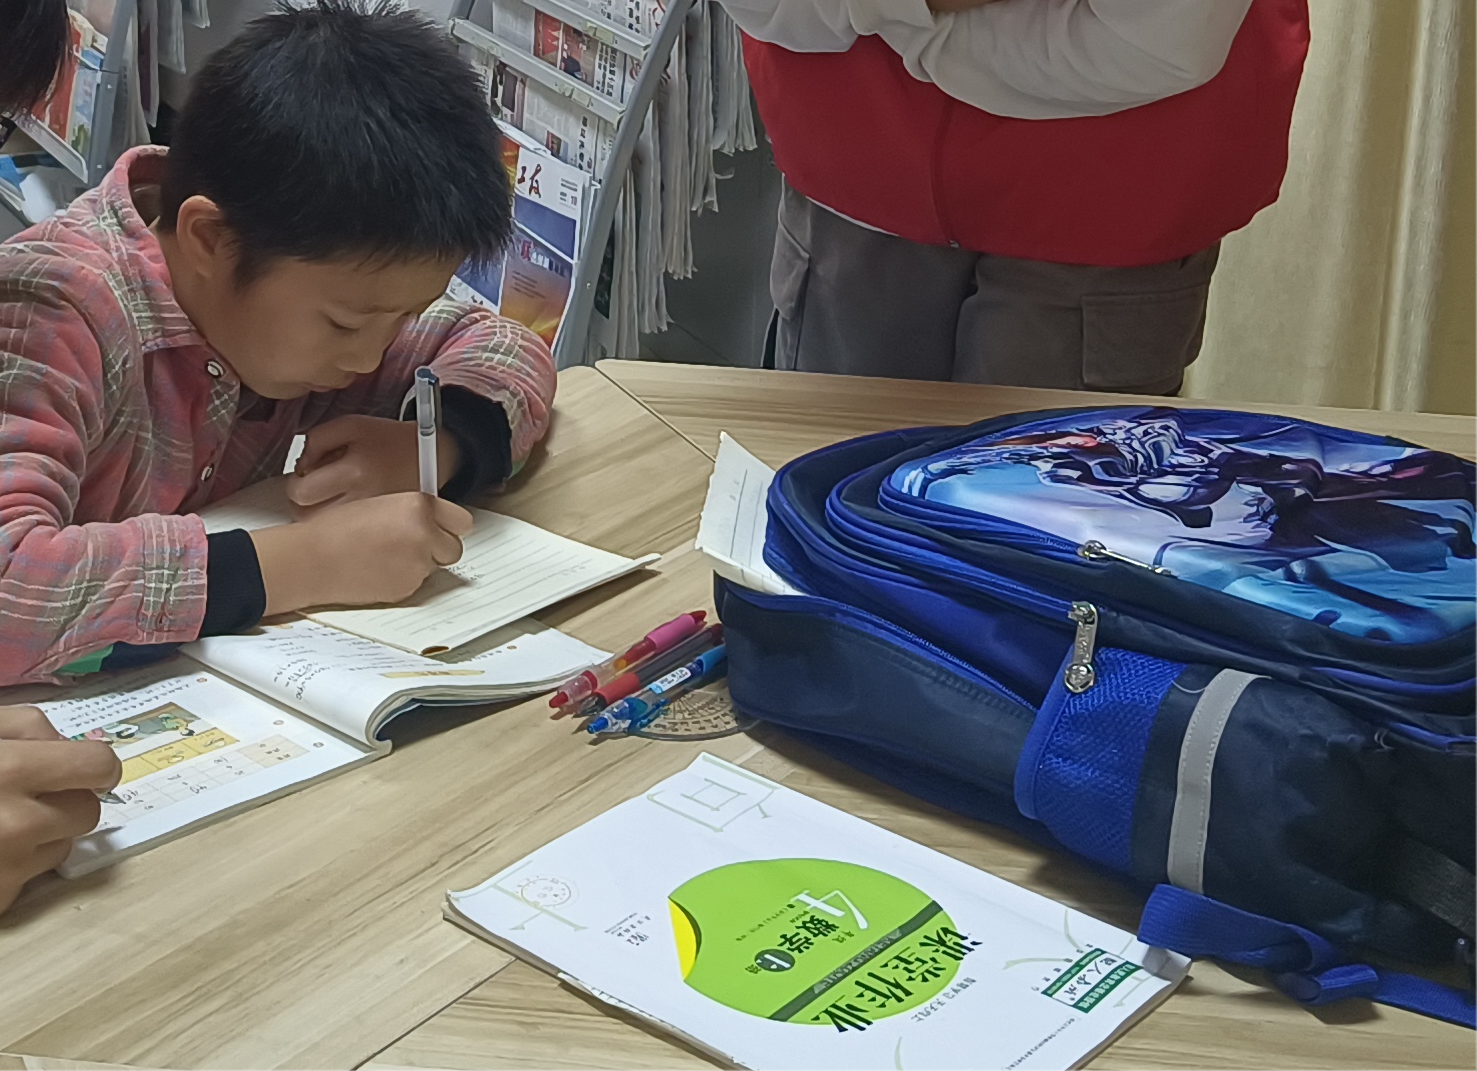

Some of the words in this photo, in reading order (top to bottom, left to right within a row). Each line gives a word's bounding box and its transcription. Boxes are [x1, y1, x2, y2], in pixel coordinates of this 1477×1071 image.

[790, 889, 869, 930] 4
[811, 927, 983, 1033] 课堂作业
